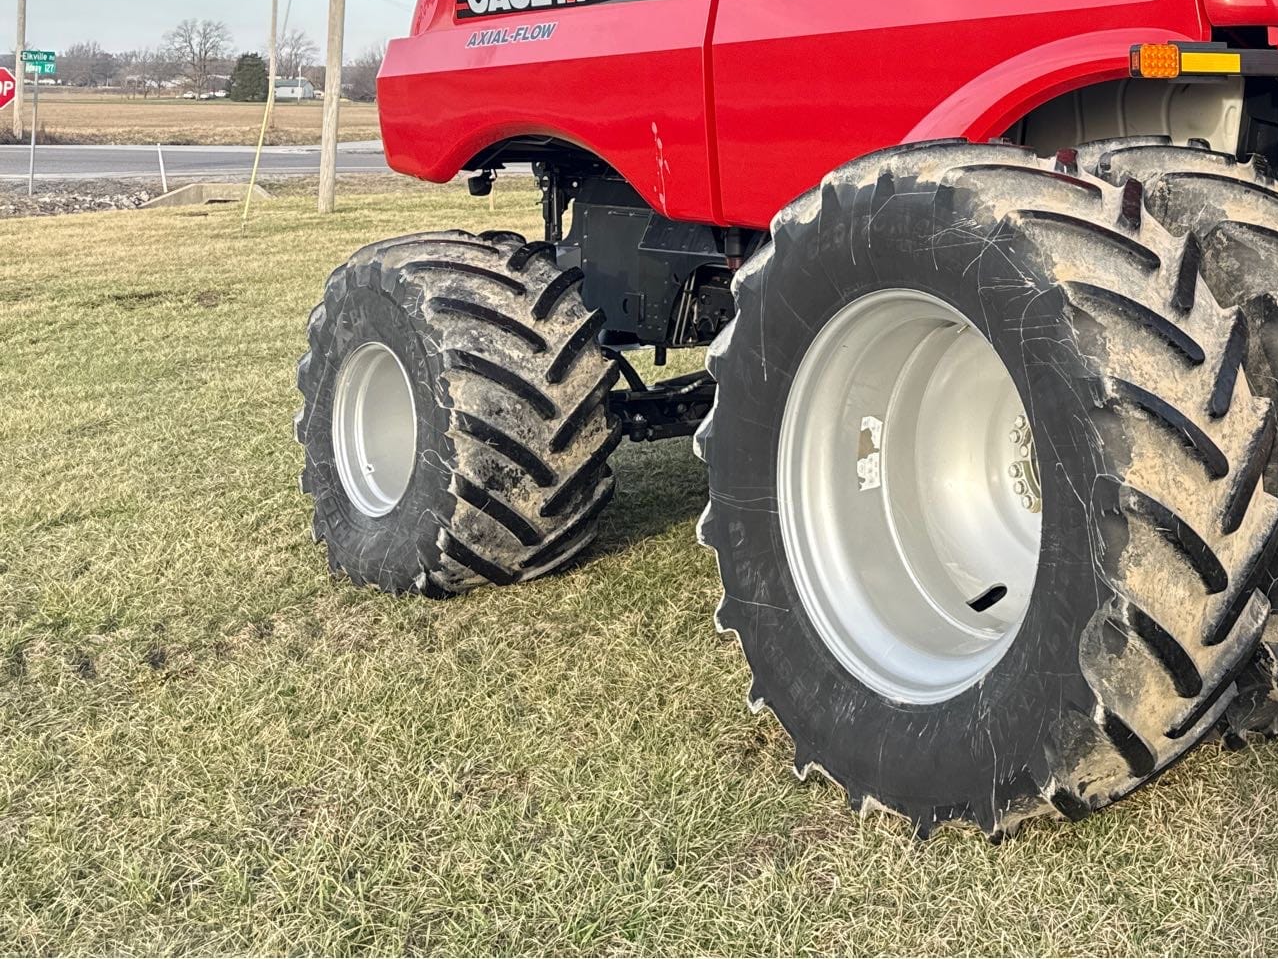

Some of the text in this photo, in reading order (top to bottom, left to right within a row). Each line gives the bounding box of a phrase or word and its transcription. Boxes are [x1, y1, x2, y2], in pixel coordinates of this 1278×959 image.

[465, 23, 558, 48] AXIAL-FLOW
[22, 52, 48, 61] Elkville
[44, 63, 54, 72] 127
